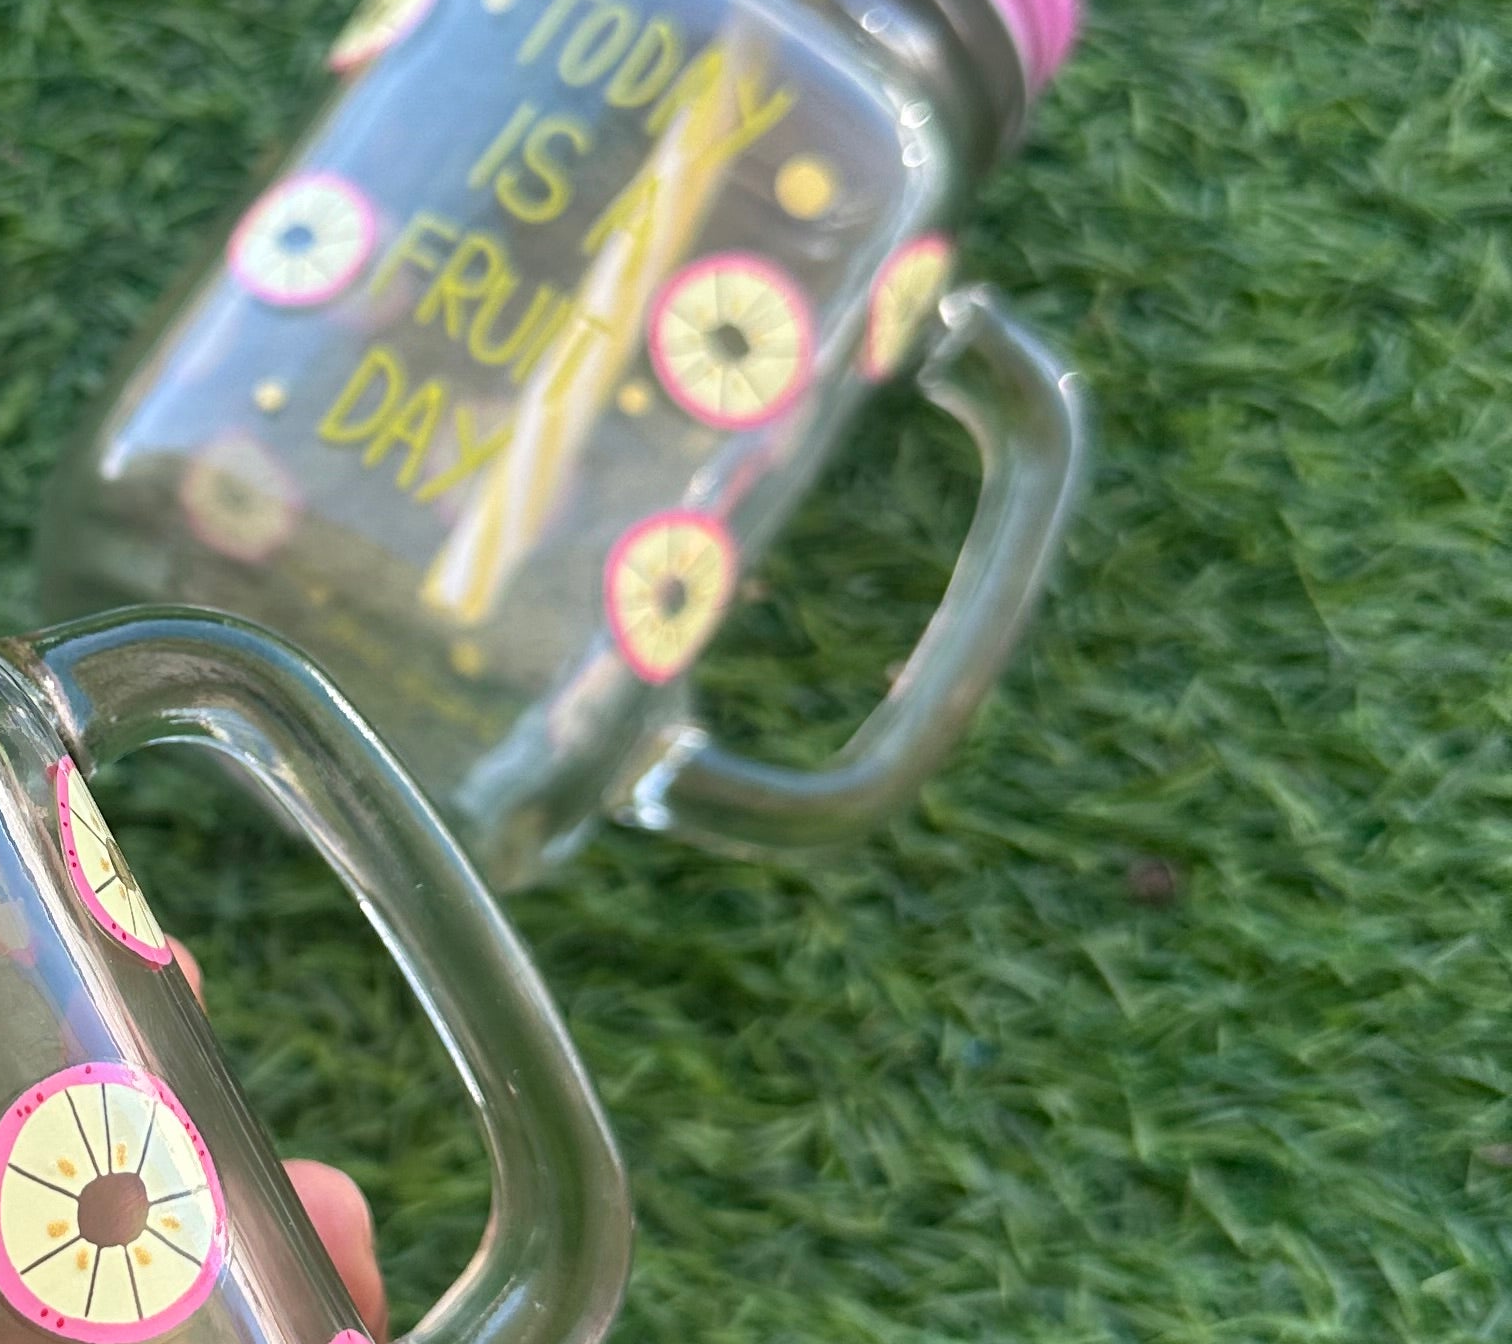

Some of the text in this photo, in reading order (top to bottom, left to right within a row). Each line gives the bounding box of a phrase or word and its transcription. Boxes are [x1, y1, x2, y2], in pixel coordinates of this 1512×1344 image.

[469, 102, 662, 279] IS A
[370, 211, 614, 404] FRUIT
[317, 347, 520, 503] DAY
